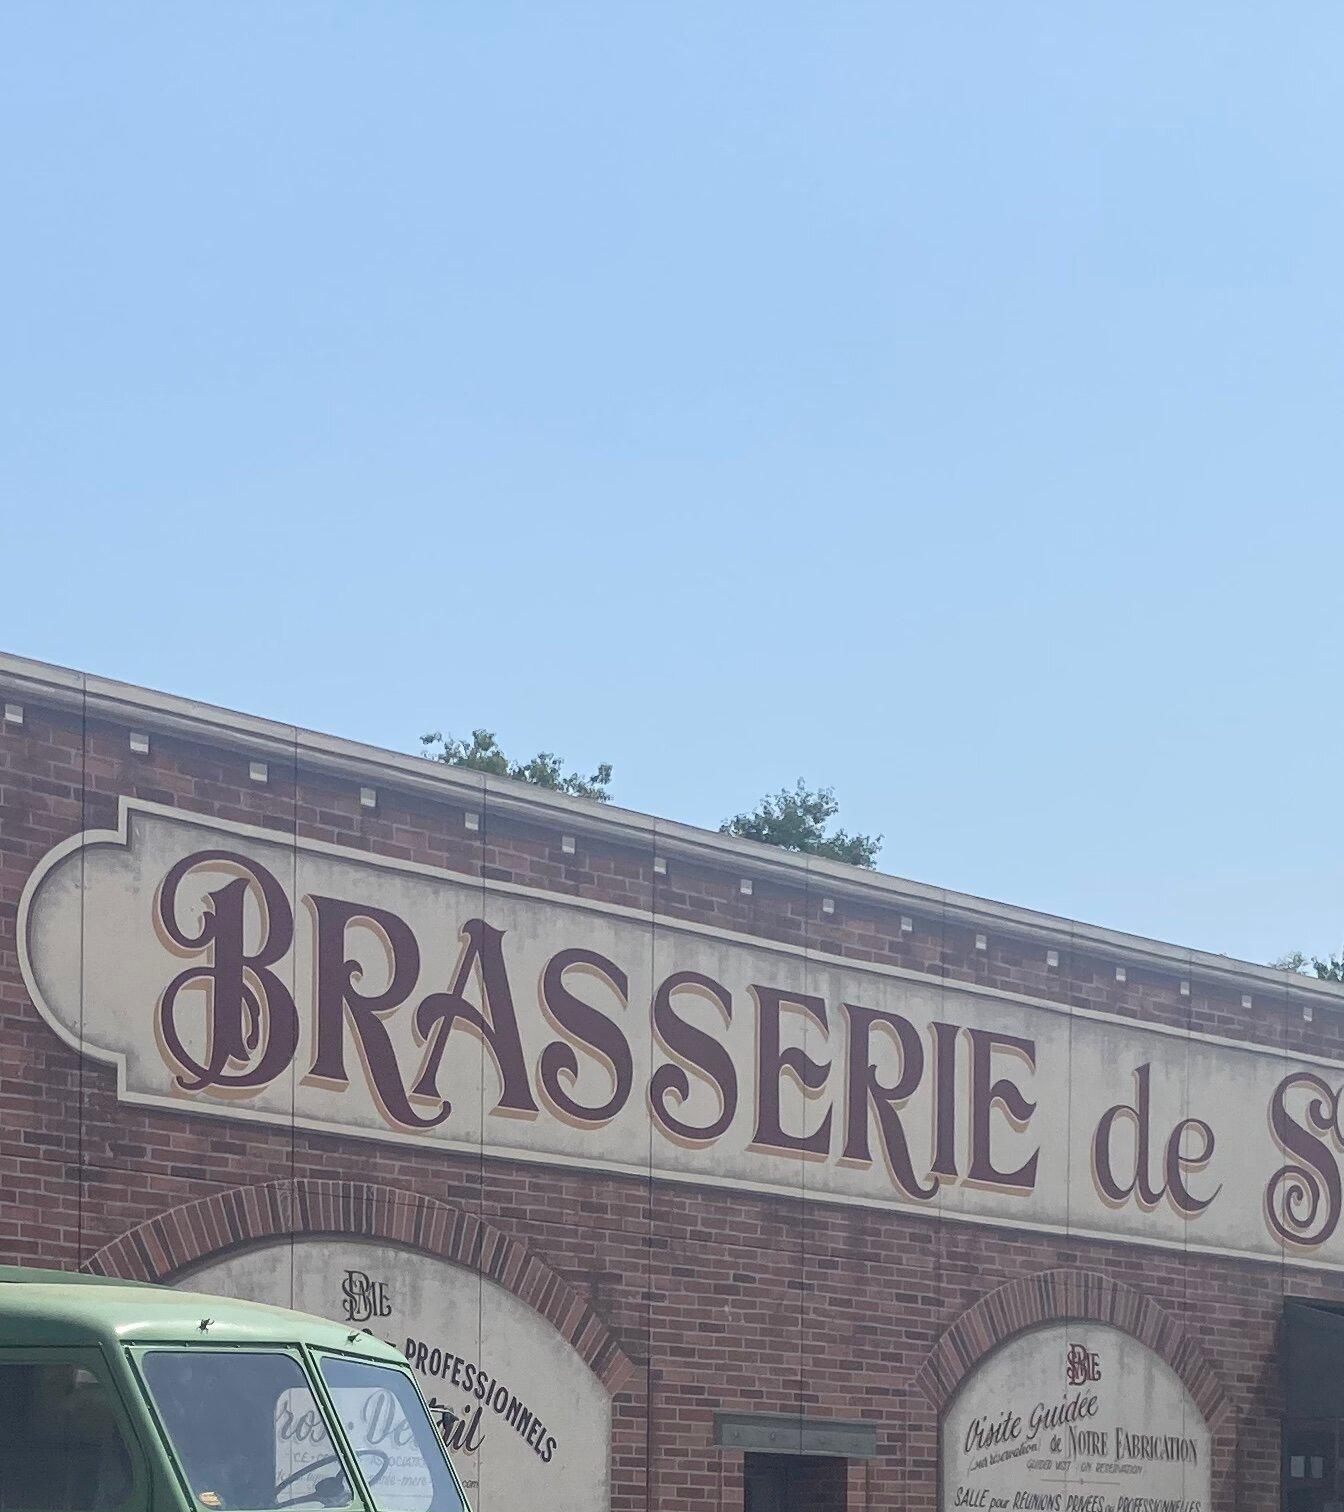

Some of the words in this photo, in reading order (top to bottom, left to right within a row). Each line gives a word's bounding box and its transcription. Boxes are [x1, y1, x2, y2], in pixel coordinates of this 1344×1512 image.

[155, 849, 1039, 1199] BRASSERIE
[1091, 1062, 1223, 1219] de
[405, 1336, 557, 1463] PROFESSIONNELS
[965, 1411, 1022, 1453] Visite
[1027, 1389, 1099, 1440] Guidée
[1066, 1424, 1107, 1460] NOTRE
[1115, 1427, 1198, 1466] FABRICATION
[954, 1486, 990, 1508] SALLE
